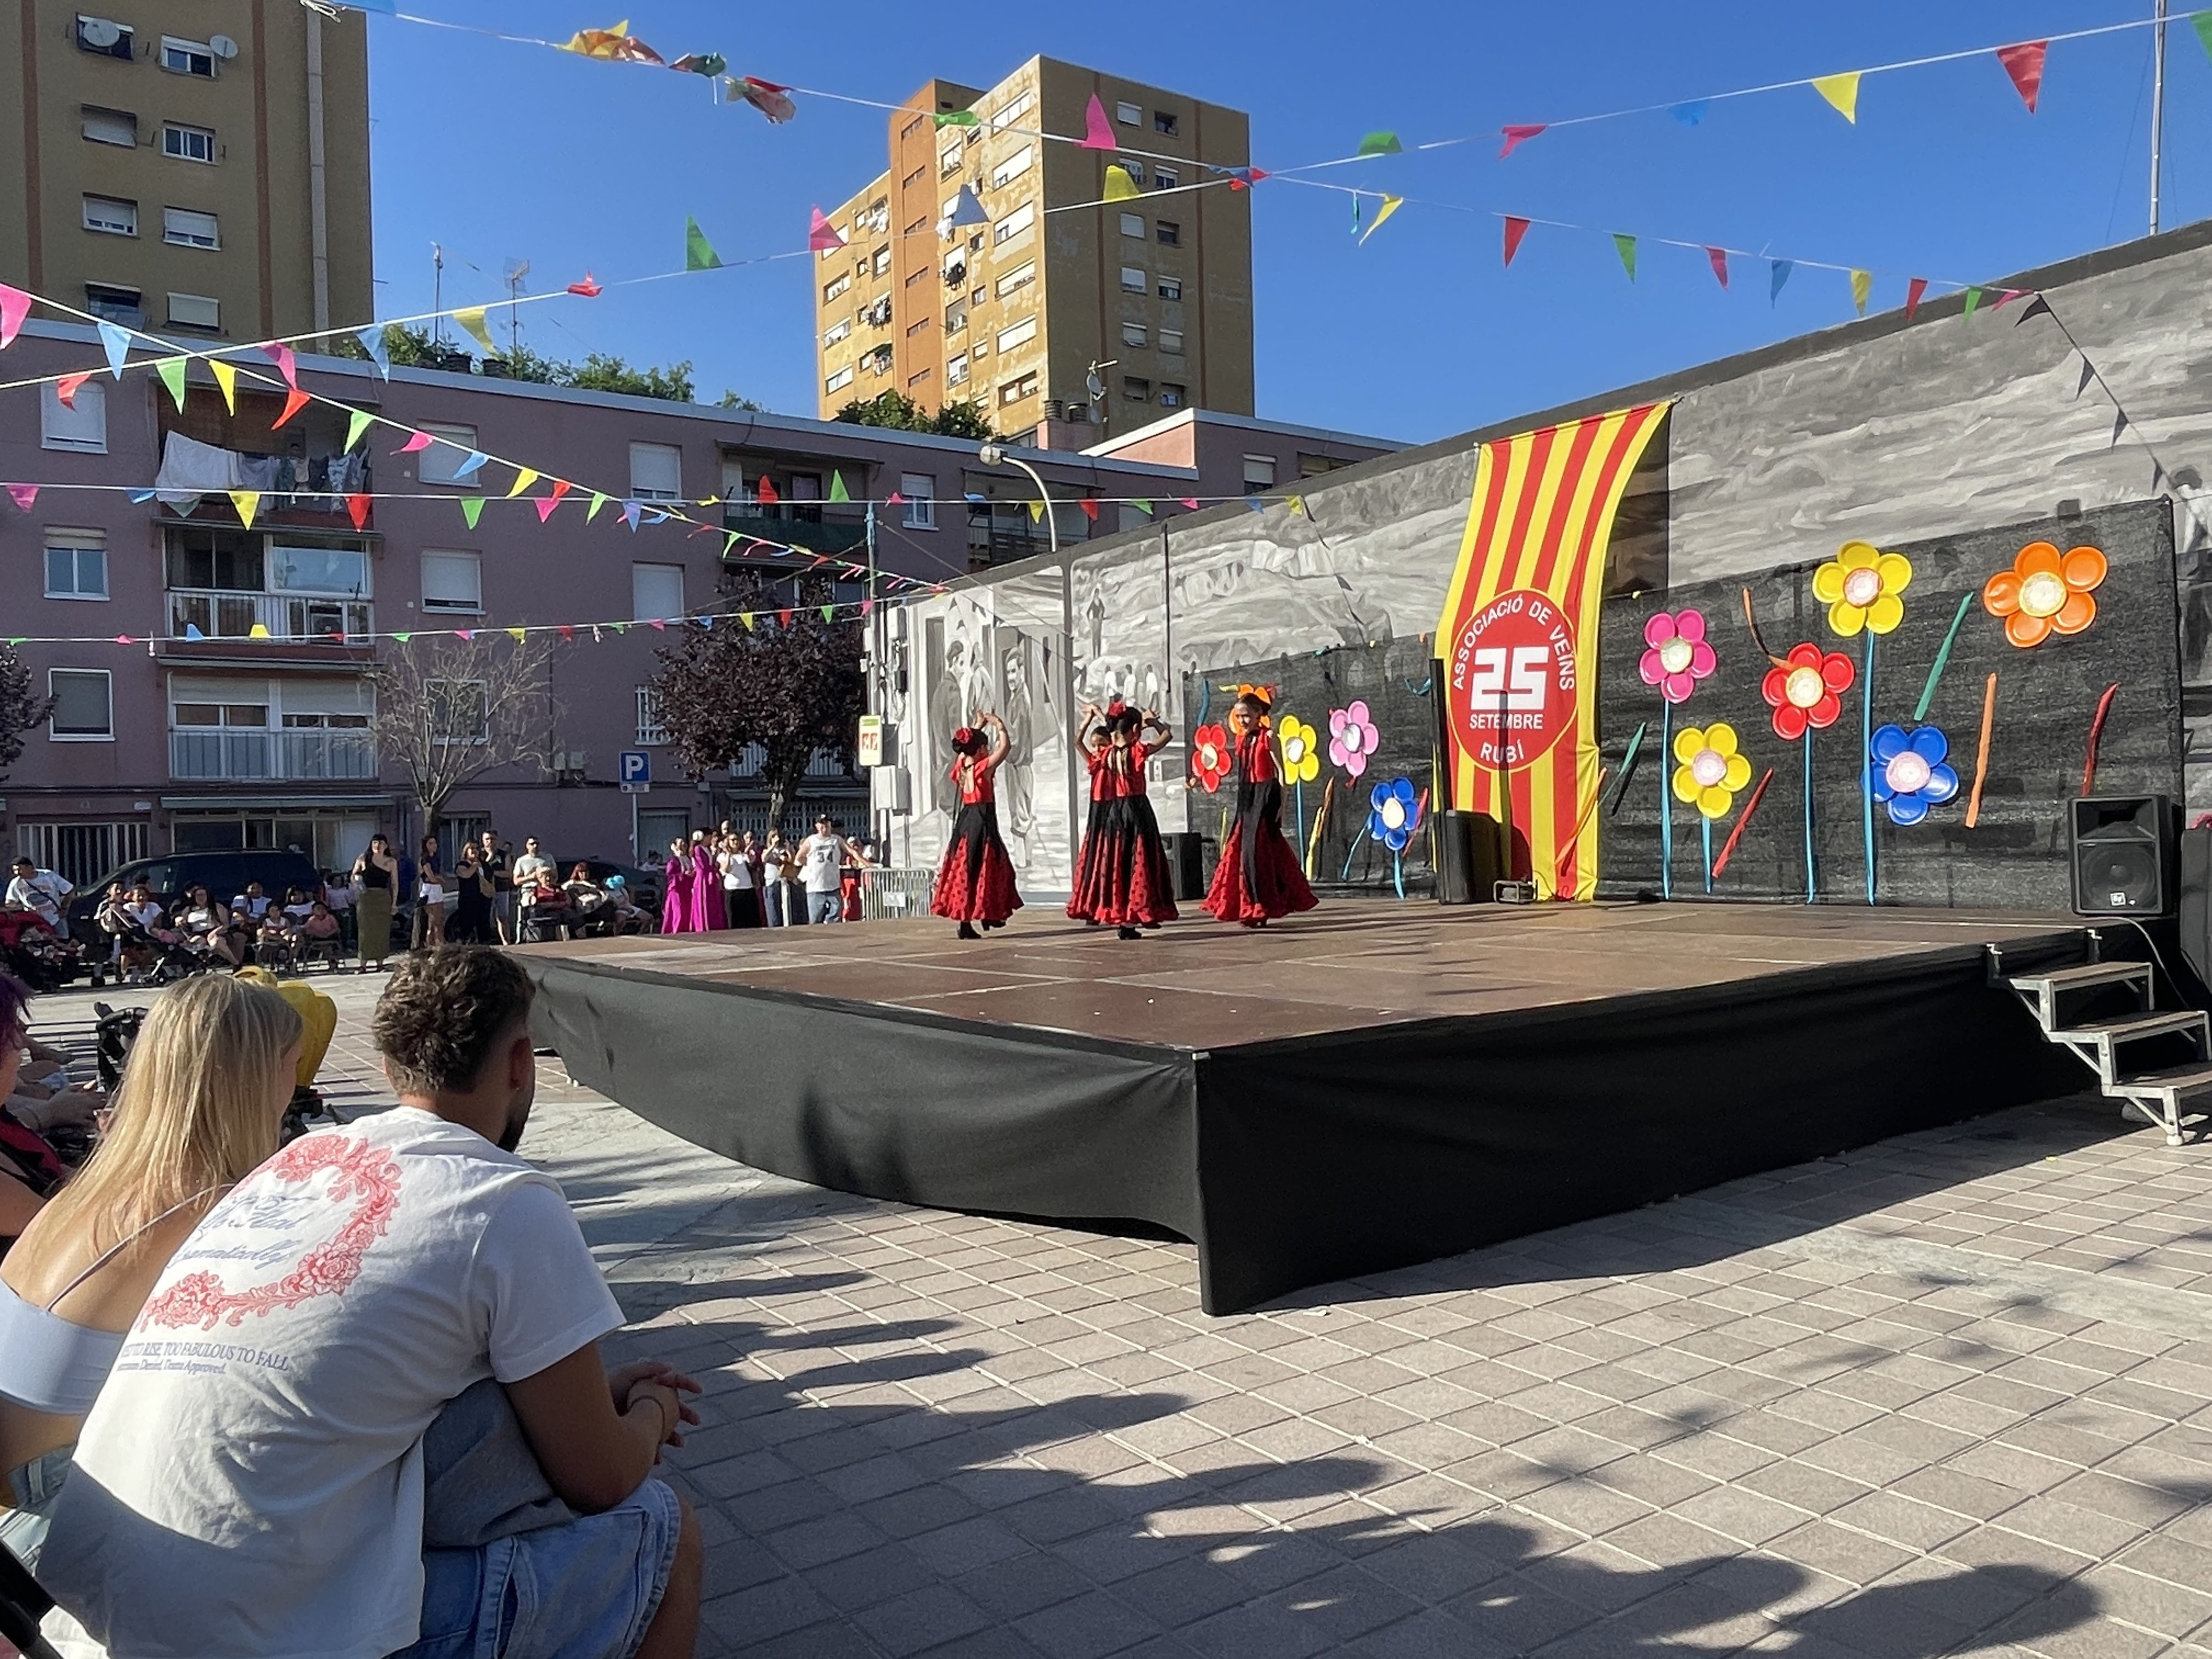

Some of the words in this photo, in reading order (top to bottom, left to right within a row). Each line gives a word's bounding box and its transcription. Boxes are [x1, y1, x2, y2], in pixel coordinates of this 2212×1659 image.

[1453, 594, 1523, 690] ASSOCIACIÓ
[1528, 600, 1553, 626] DE
[1470, 646, 1548, 710] 25
[1469, 713, 1544, 730] SETEMBRE
[1480, 738, 1525, 764] RUBÍ
[625, 755, 644, 780] P
[817, 850, 834, 864] 34
[180, 1342, 237, 1361] FABULOUS
[236, 1347, 256, 1363] TO
[255, 1351, 289, 1372] FALL
